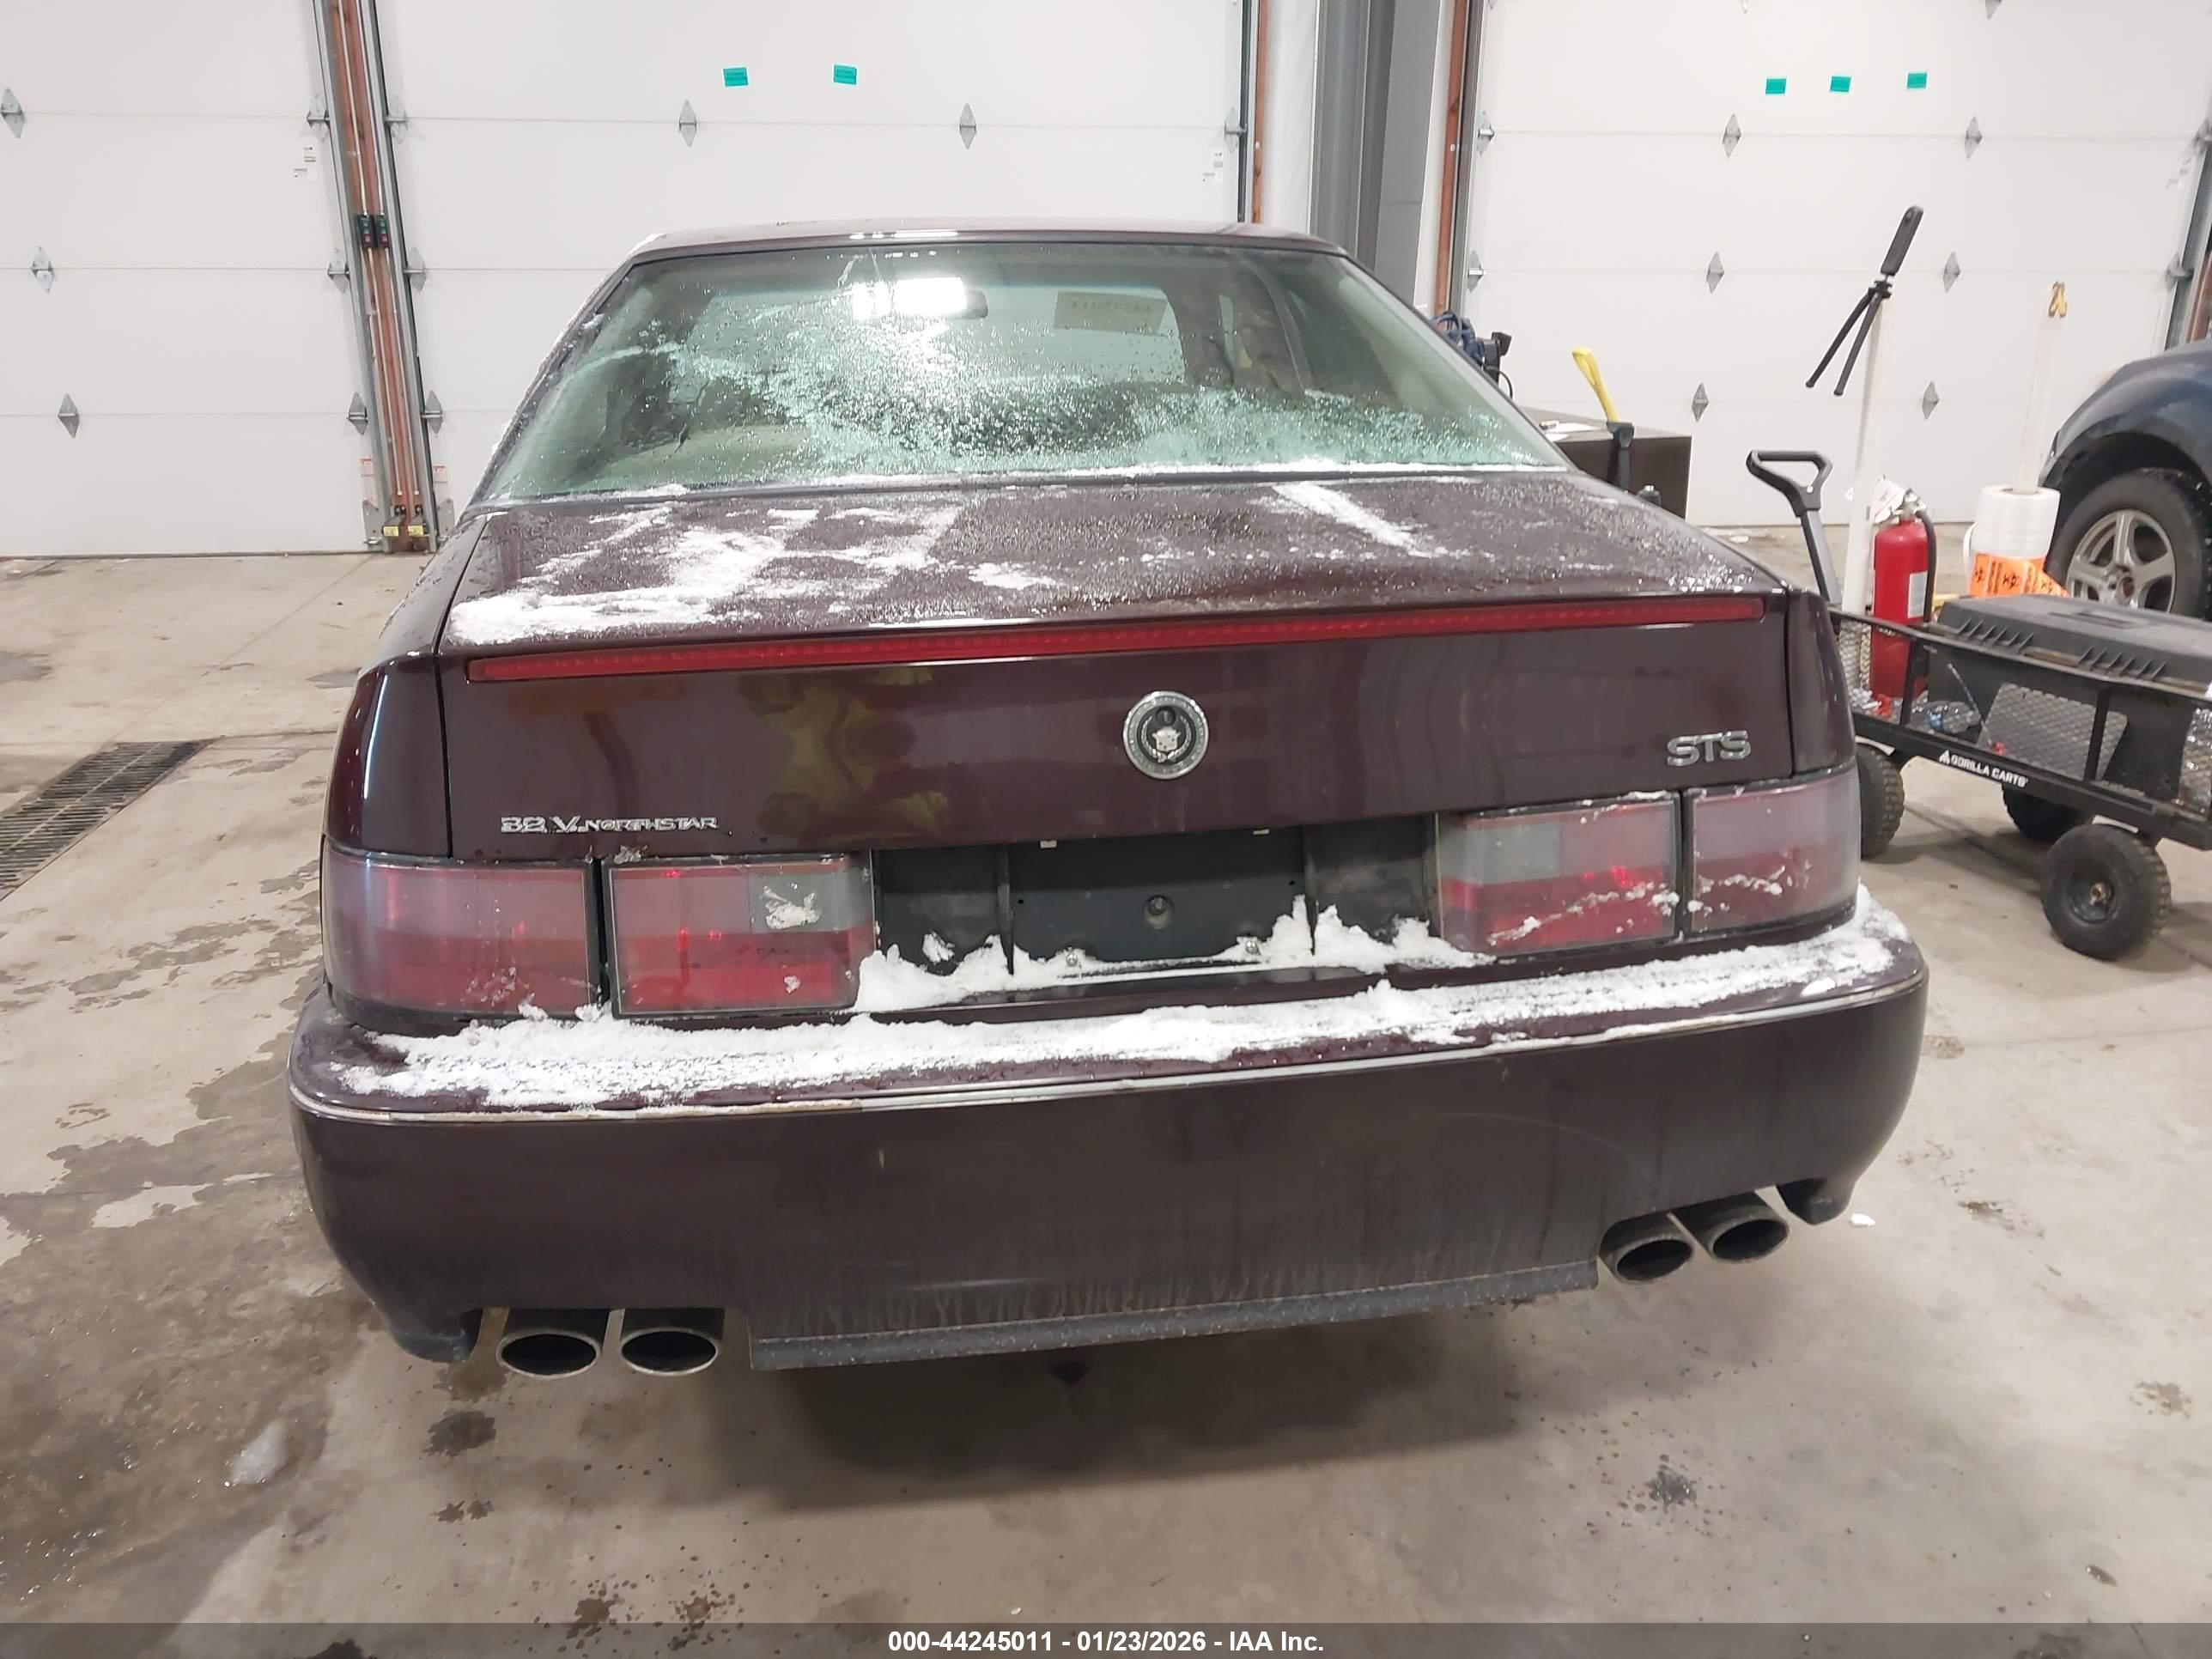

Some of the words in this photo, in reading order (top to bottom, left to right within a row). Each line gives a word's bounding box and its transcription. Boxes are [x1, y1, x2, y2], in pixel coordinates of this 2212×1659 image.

[1667, 730, 1752, 767] STS
[1951, 754, 1990, 777] GORILLA
[581, 816, 719, 833] NORTHSTAR
